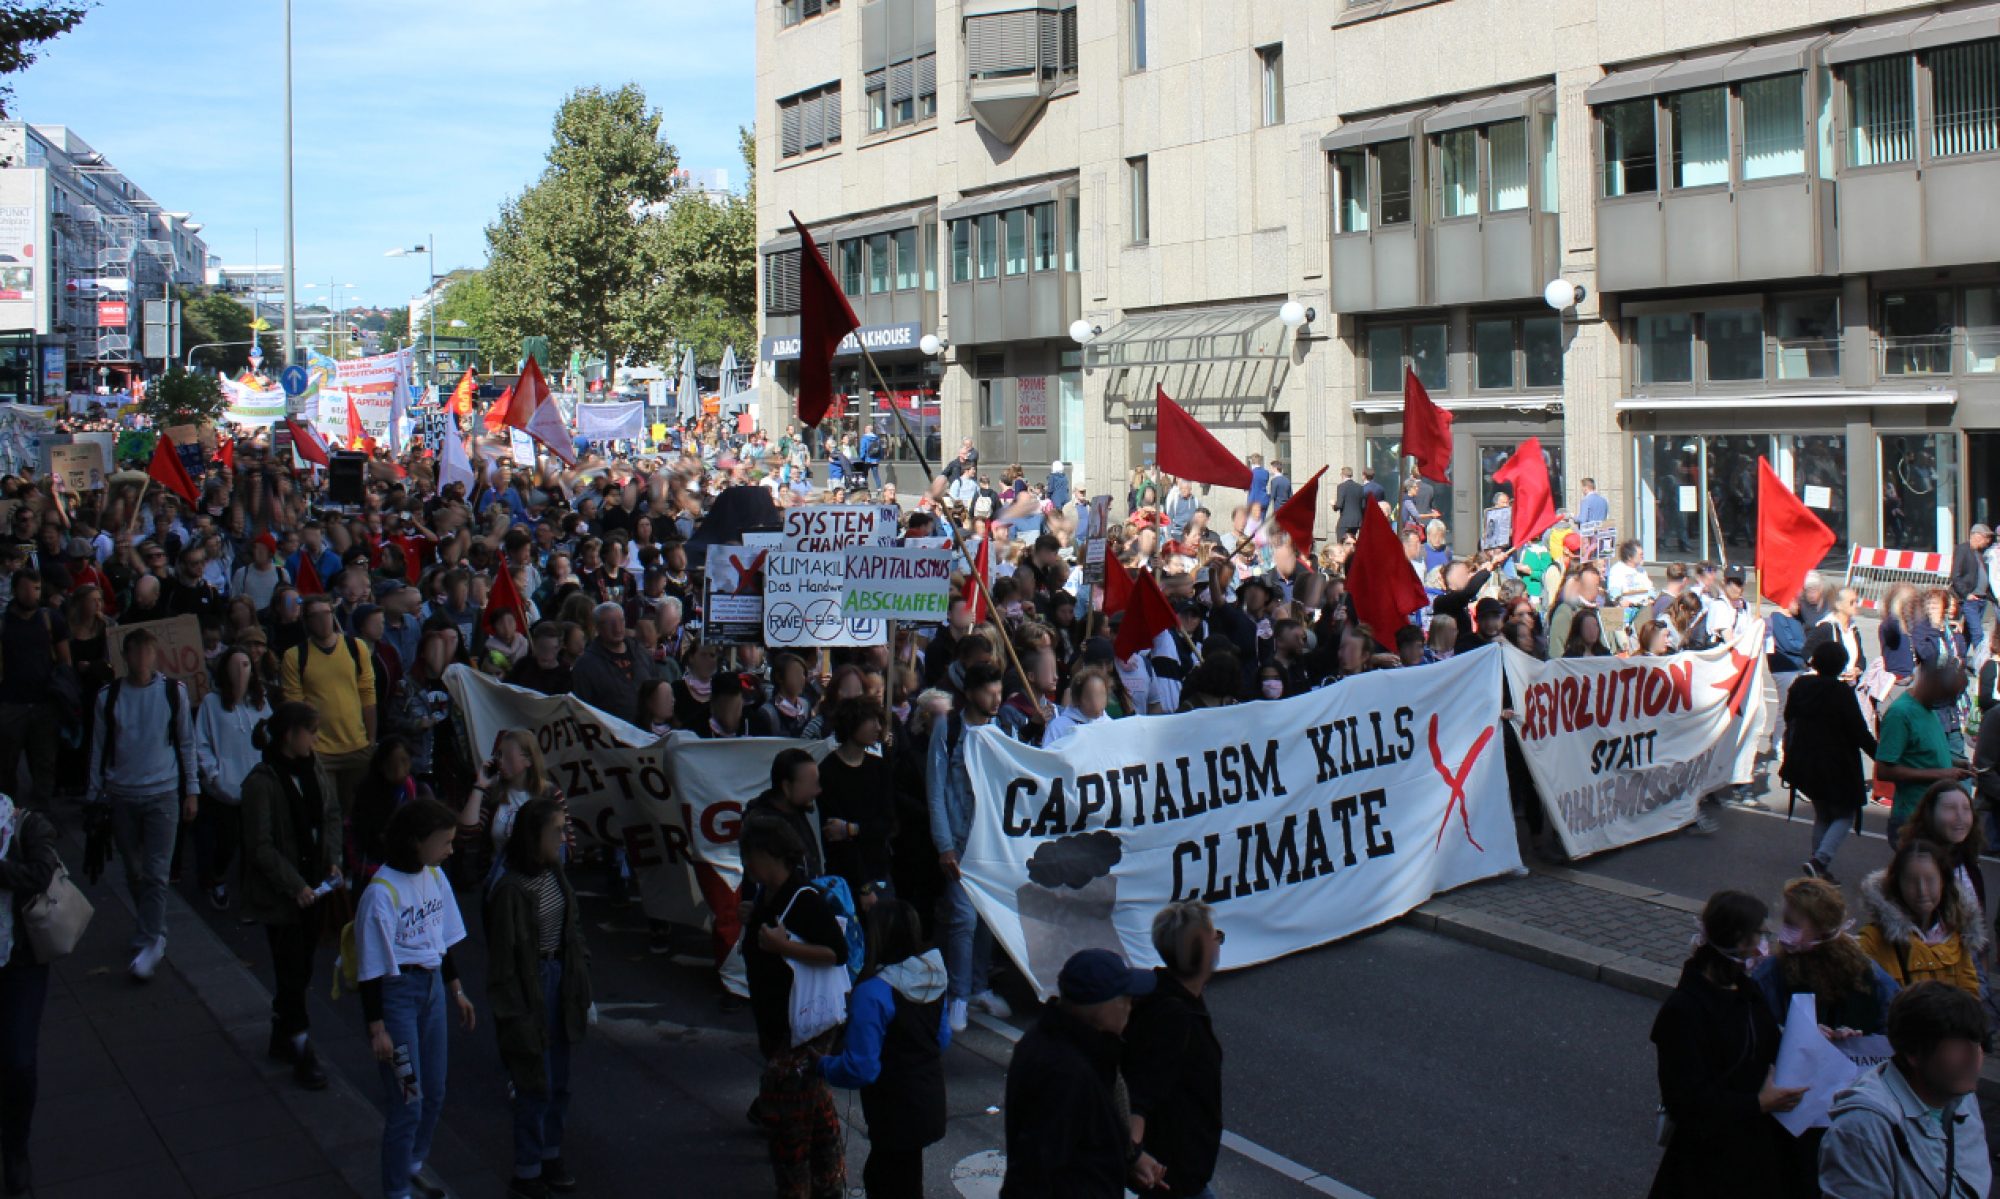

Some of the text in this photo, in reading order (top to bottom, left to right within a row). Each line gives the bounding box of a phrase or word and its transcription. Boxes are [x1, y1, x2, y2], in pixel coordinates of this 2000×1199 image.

[842, 327, 912, 349] STEAKHOUSE
[1018, 377, 1046, 390] PRIME
[1019, 403, 1030, 414] ON
[1018, 415, 1046, 427] ROCKS
[786, 511, 874, 537] SYSTEM
[768, 556, 843, 577] KLIMAKIL
[845, 555, 951, 580] KAPITALISMUS
[768, 579, 843, 593] Das Handwe
[844, 589, 948, 613] ABSCHAFFEN
[769, 614, 801, 630] RWE
[1521, 660, 1693, 742] REVOLUTION
[1590, 729, 1658, 775] STATT
[1003, 706, 1416, 837] CAPITALISM KILLS
[1171, 788, 1395, 902] CLIMATE
